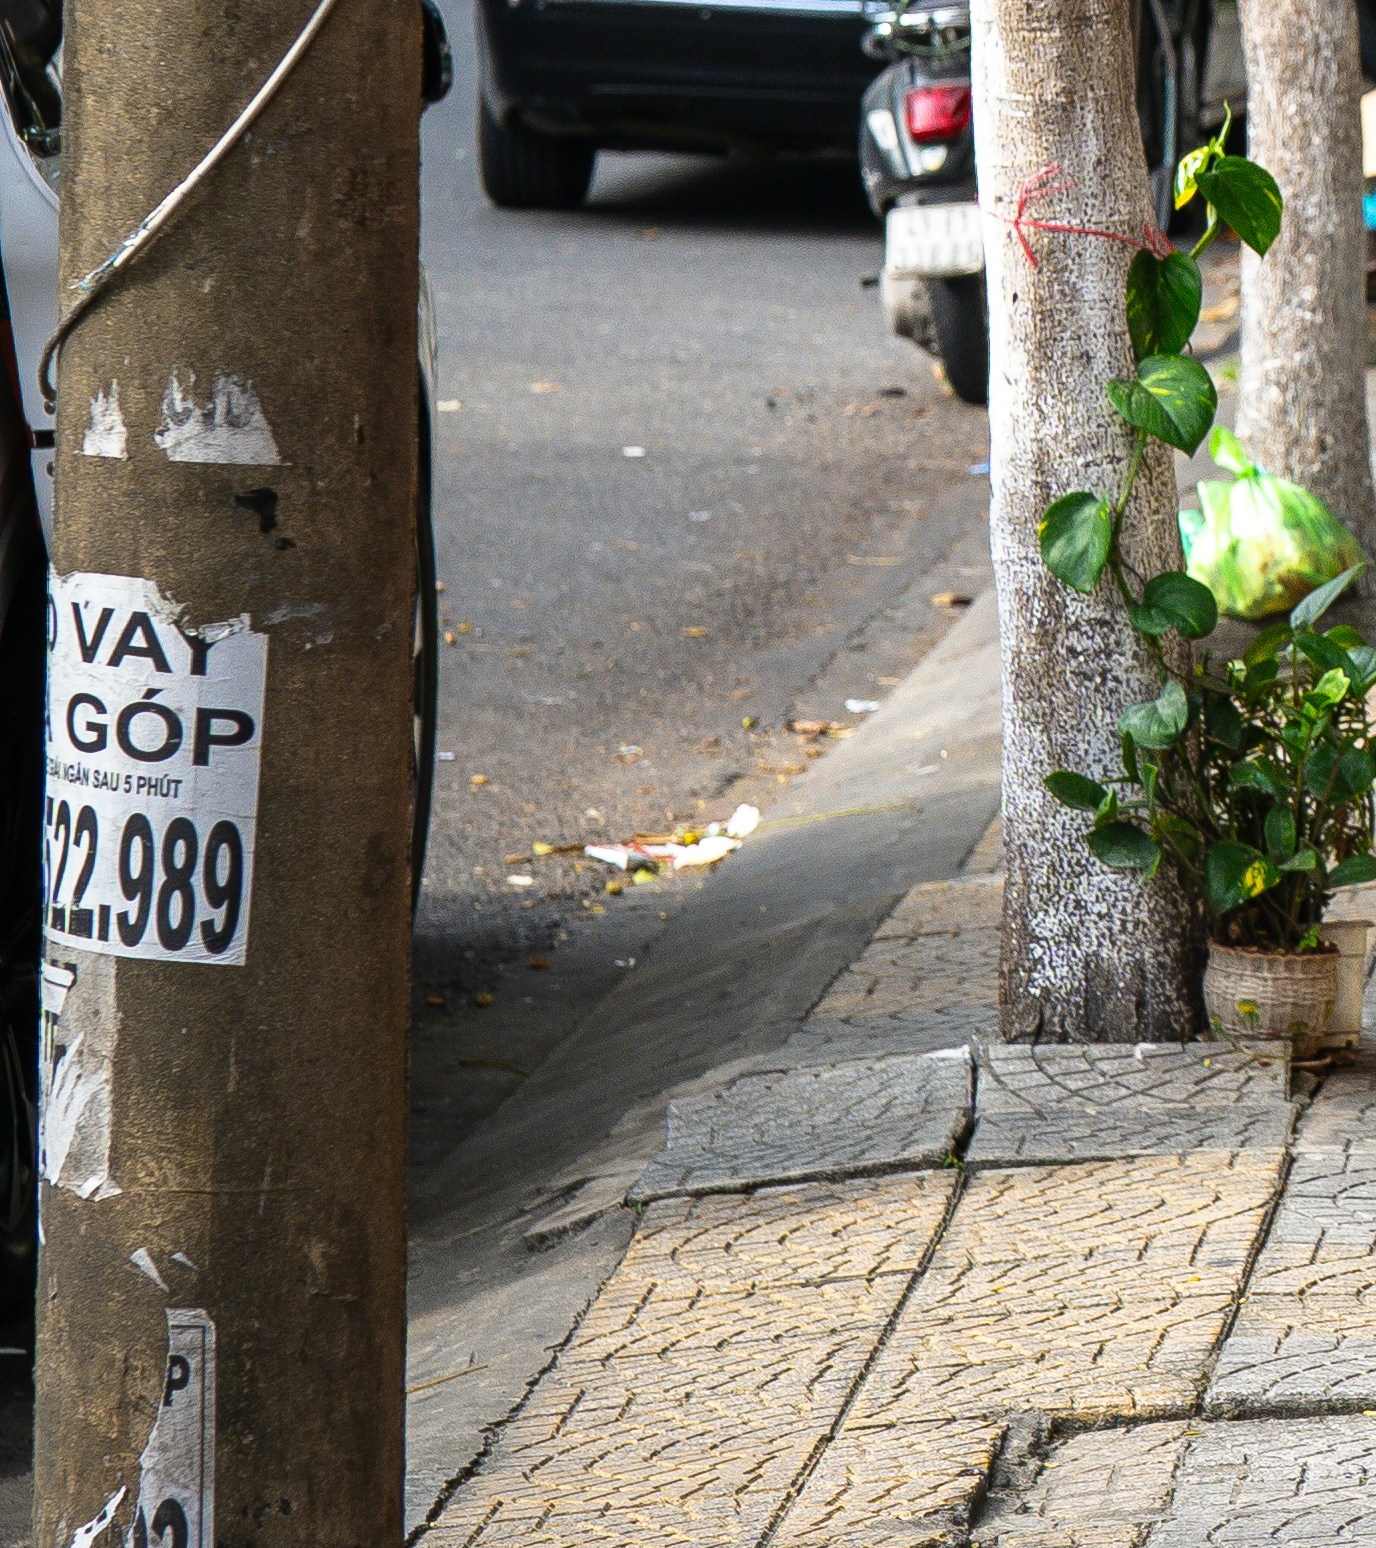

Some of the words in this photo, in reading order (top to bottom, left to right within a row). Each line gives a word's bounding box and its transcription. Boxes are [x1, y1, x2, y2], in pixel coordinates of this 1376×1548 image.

[70, 600, 221, 678] VAY
[65, 688, 255, 768] GÓP
[92, 767, 119, 793] SAU
[123, 774, 133, 795] 5
[136, 770, 183, 800] PHÚT
